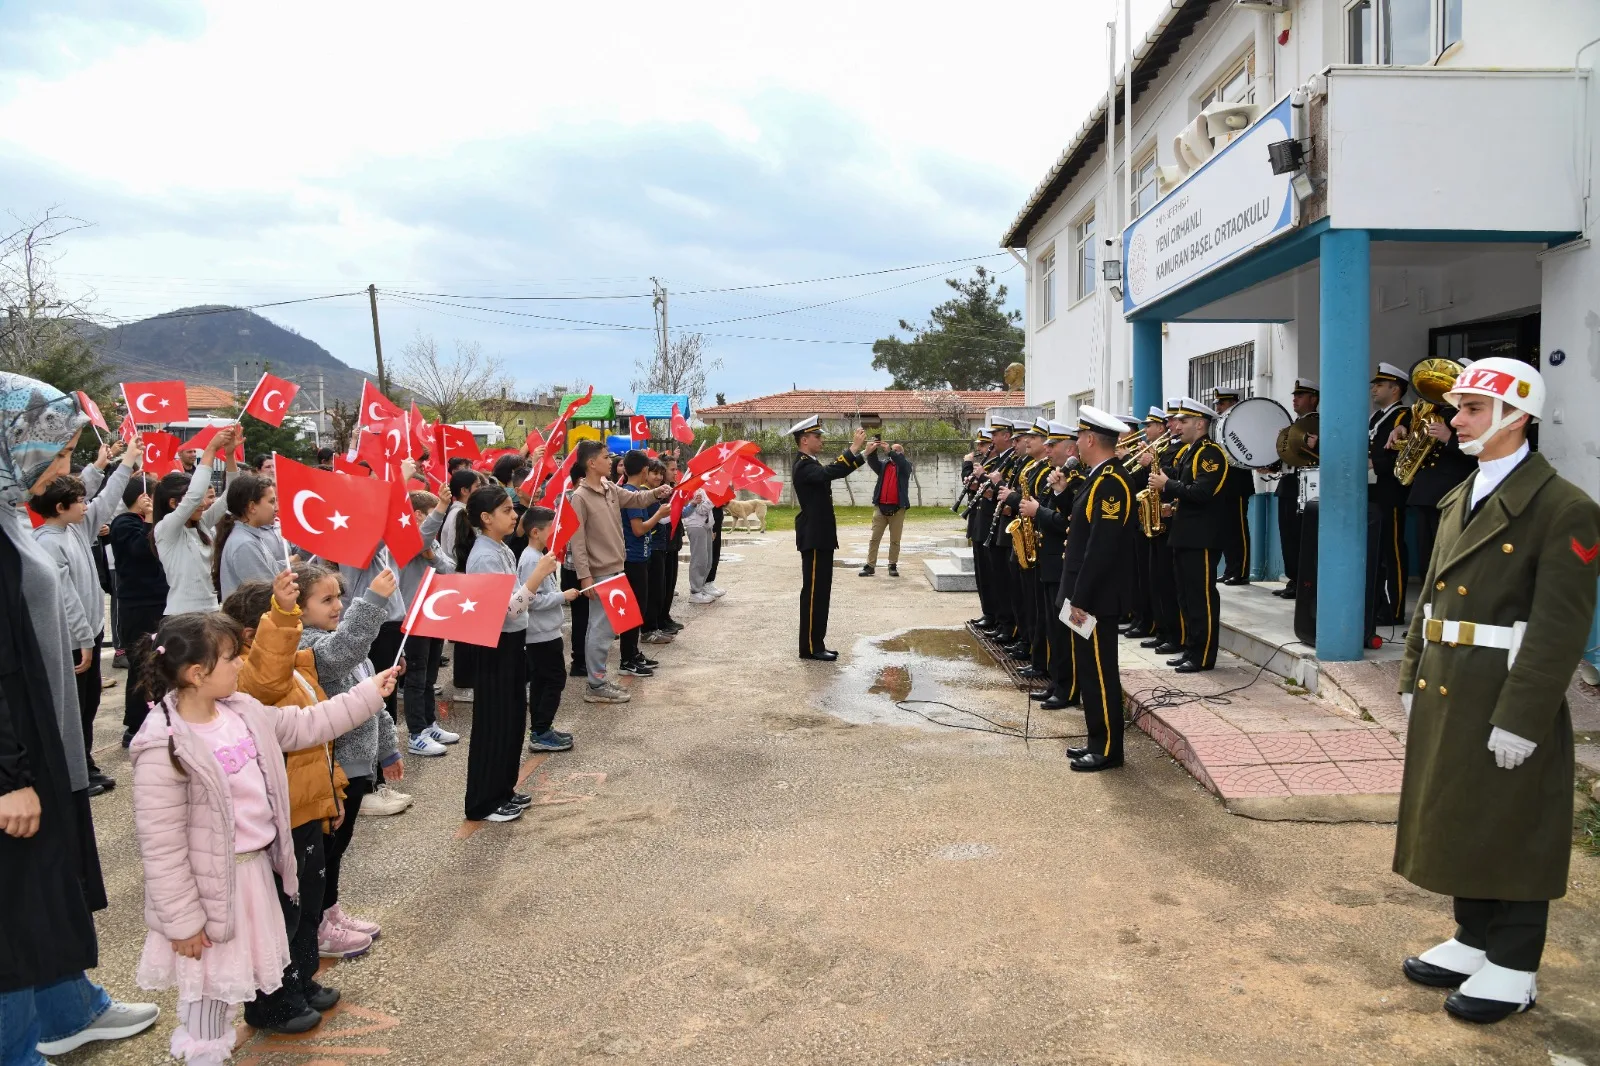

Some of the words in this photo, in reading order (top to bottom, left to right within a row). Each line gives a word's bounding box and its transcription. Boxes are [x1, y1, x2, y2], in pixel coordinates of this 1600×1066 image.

[1156, 227, 1170, 254] YENİ
[1171, 208, 1202, 244] ORHANLI
[1156, 249, 1188, 281] KAMURAN
[1190, 232, 1213, 259] BAŞEL
[1214, 196, 1270, 246] ORTAOKULU
[1228, 430, 1249, 456] YAMAHA
